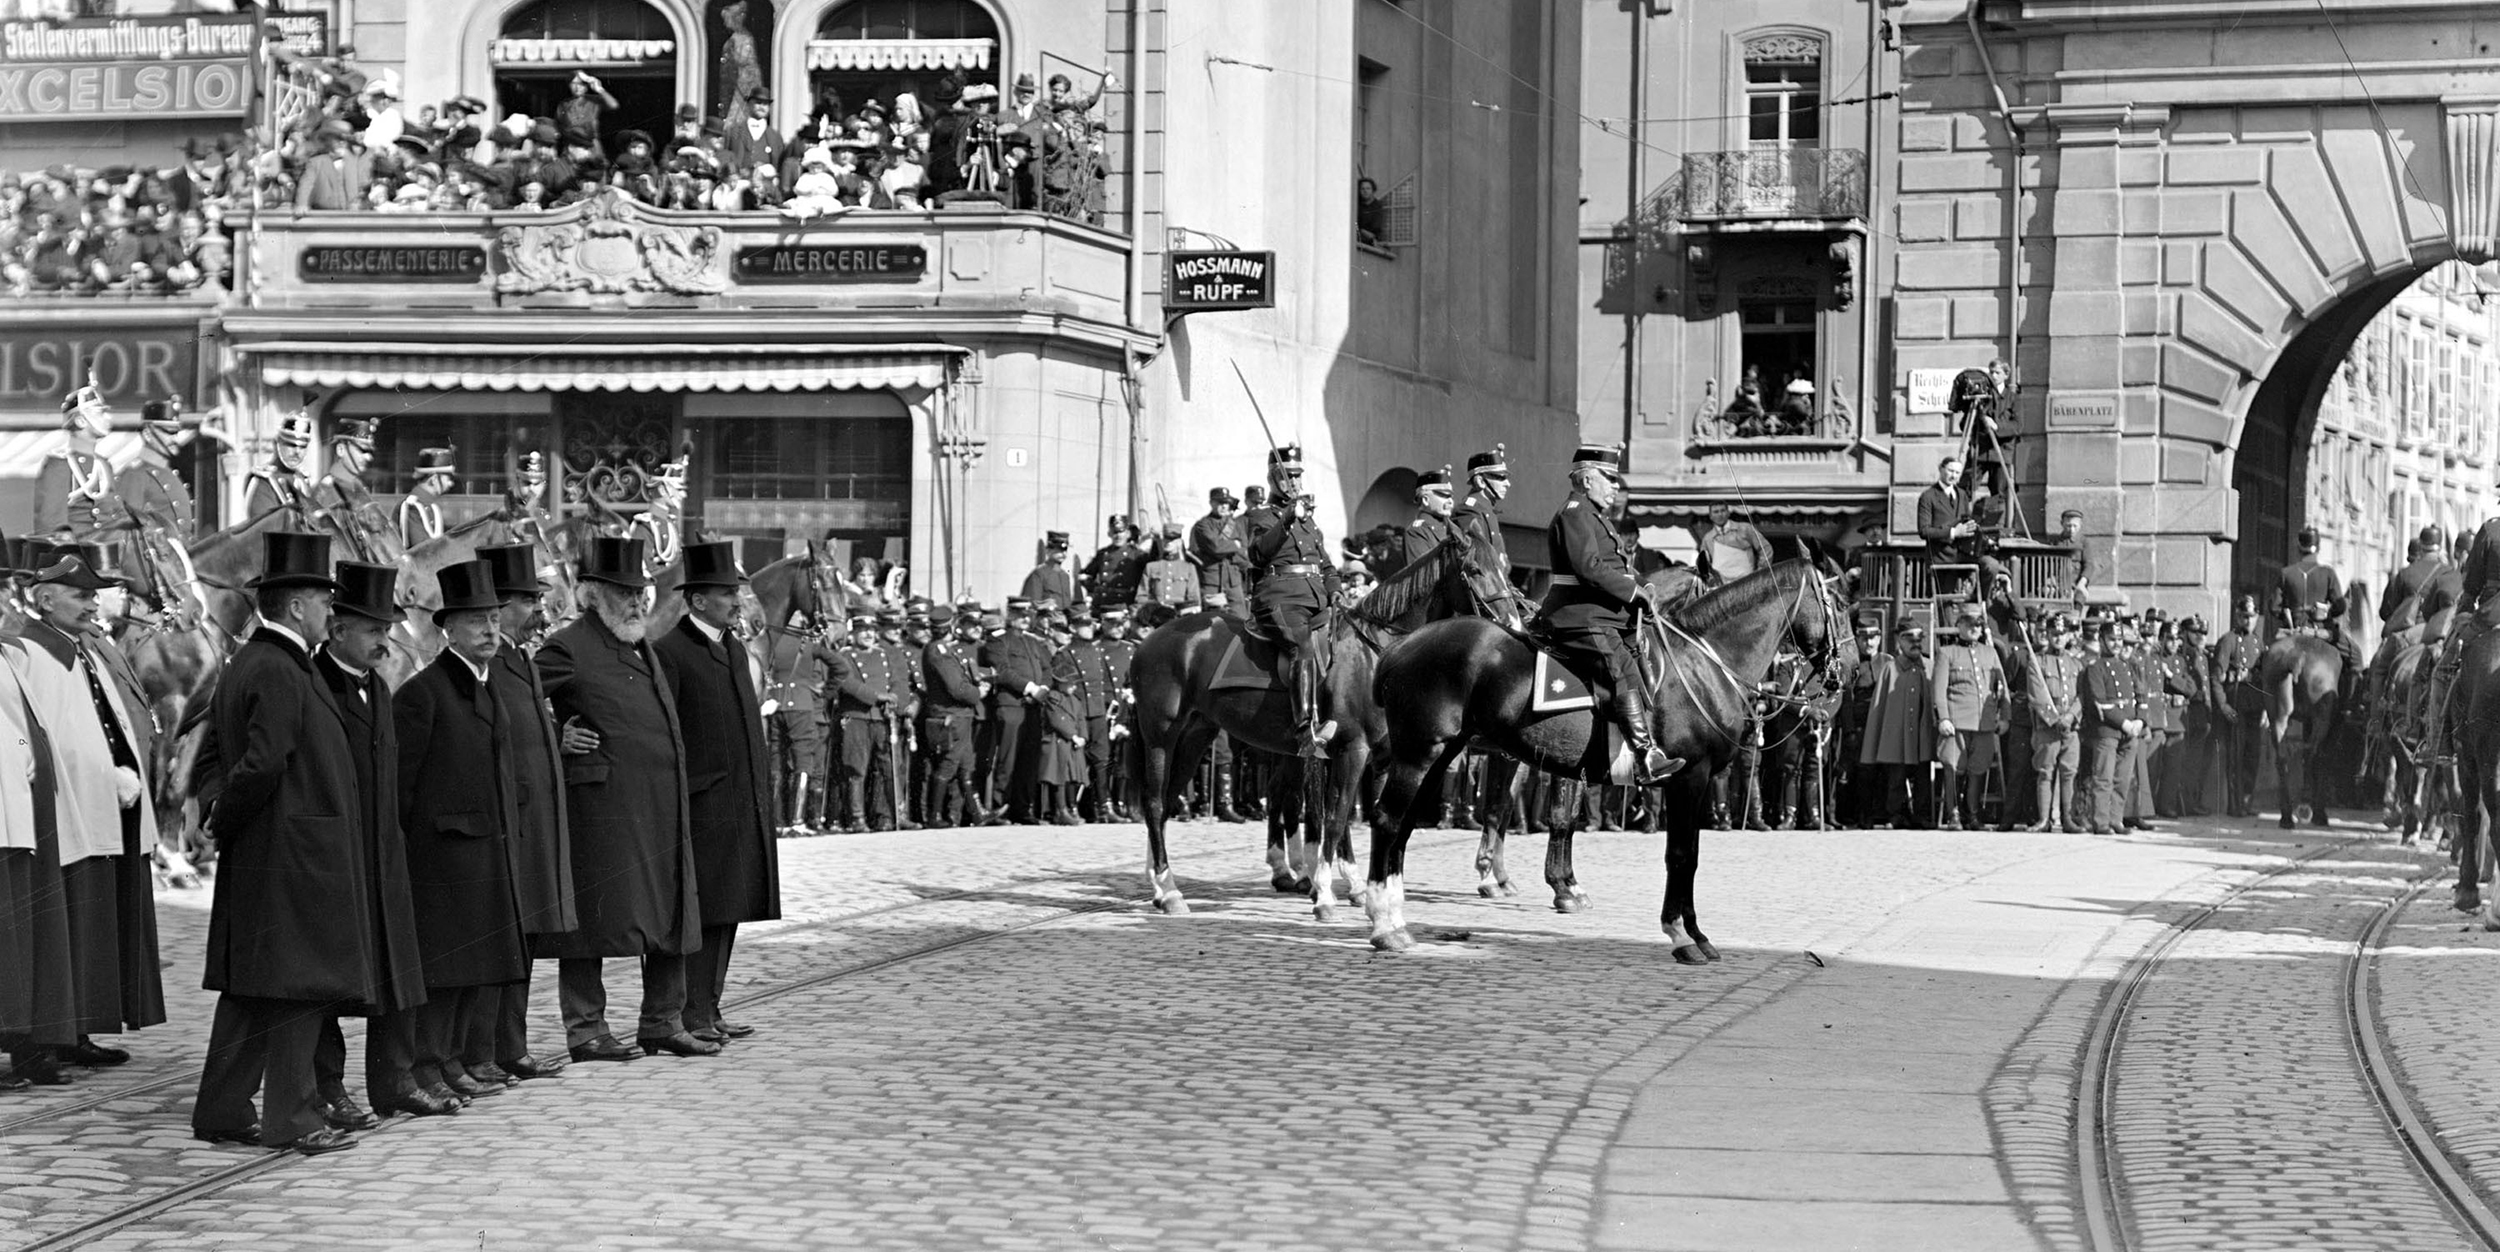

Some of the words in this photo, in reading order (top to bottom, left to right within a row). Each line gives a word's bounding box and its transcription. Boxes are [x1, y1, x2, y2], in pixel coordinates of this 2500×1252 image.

[4, 18, 254, 60] Stellenvermittlungs-Bureau
[0, 64, 250, 113] XCELSIO
[319, 250, 469, 271] PASSEMENTERIE
[773, 250, 889, 271] MERCERIE
[1175, 257, 1264, 280] HOSSMANN
[1213, 274, 1223, 283] &
[1193, 284, 1244, 300] RUPF
[0, 341, 179, 396] LSIOR
[2053, 404, 2113, 416] BÄRENPLATZ
